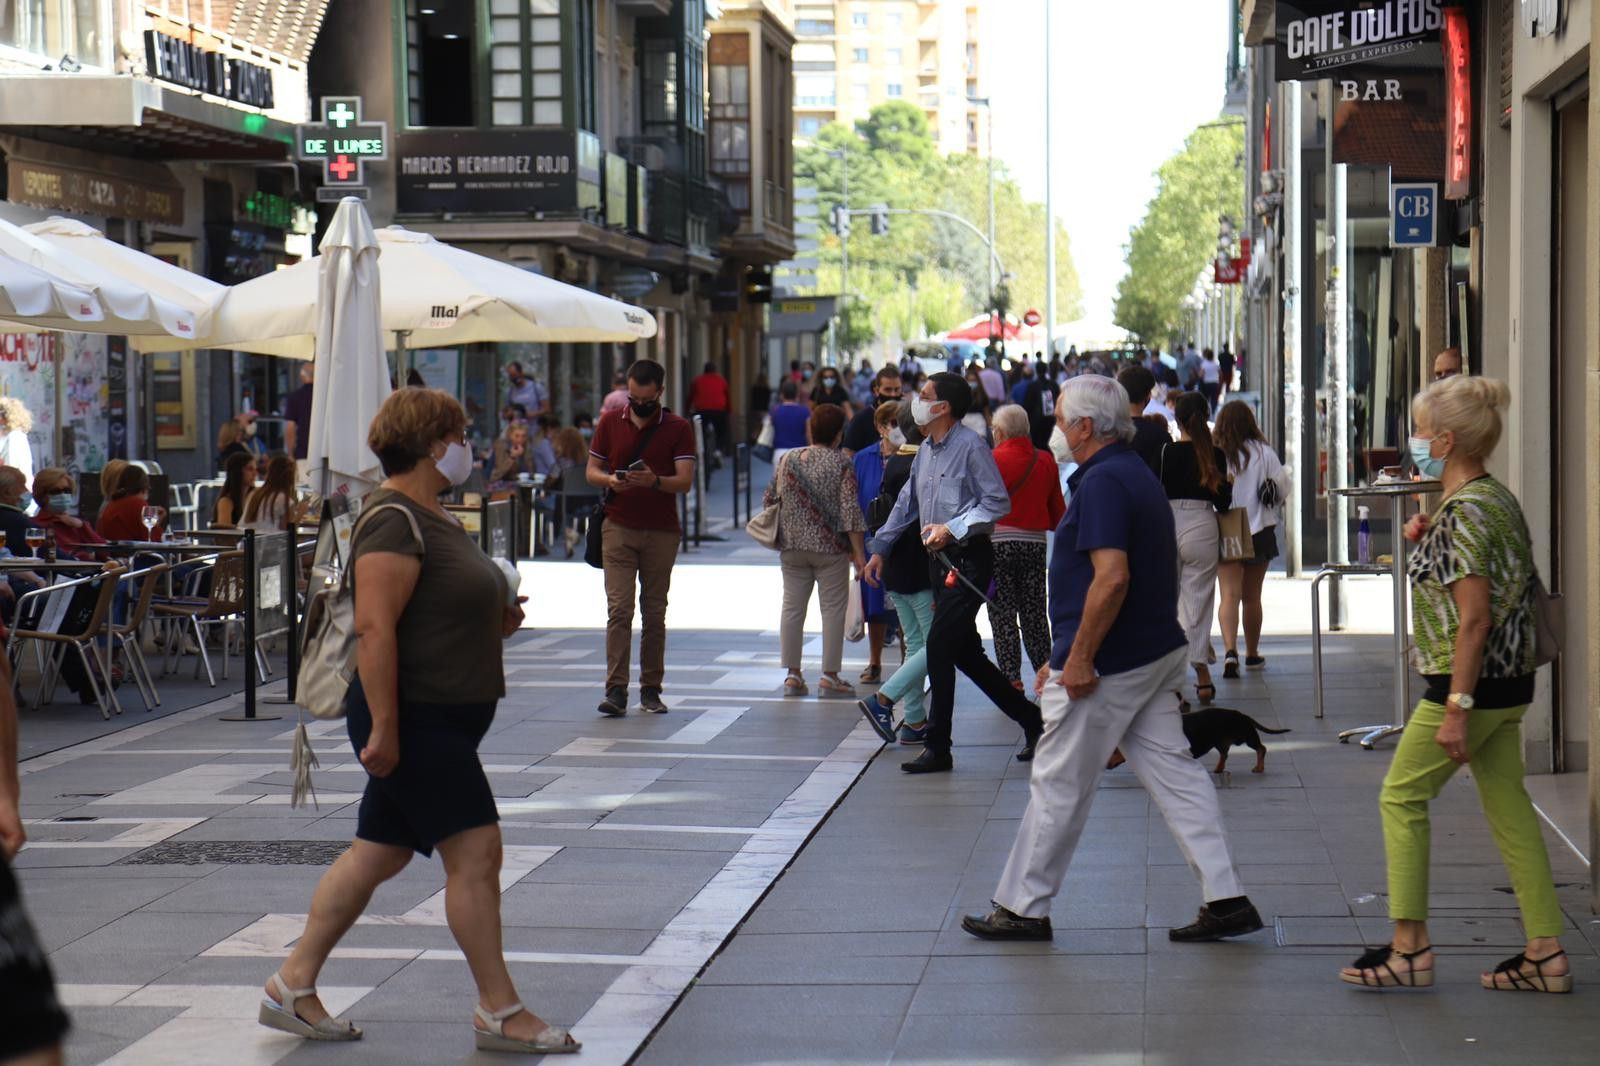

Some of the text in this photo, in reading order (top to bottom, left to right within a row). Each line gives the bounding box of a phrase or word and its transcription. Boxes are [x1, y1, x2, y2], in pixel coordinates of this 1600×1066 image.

[1287, 11, 1345, 60] CAFE
[1315, 41, 1414, 68] TAPAS & EXPRESSO
[1340, 79, 1403, 101] BAR
[305, 139, 382, 154] DE LUNES
[402, 155, 569, 175] MARCOS HERNANDEZ ROJO
[1398, 195, 1430, 218] CB
